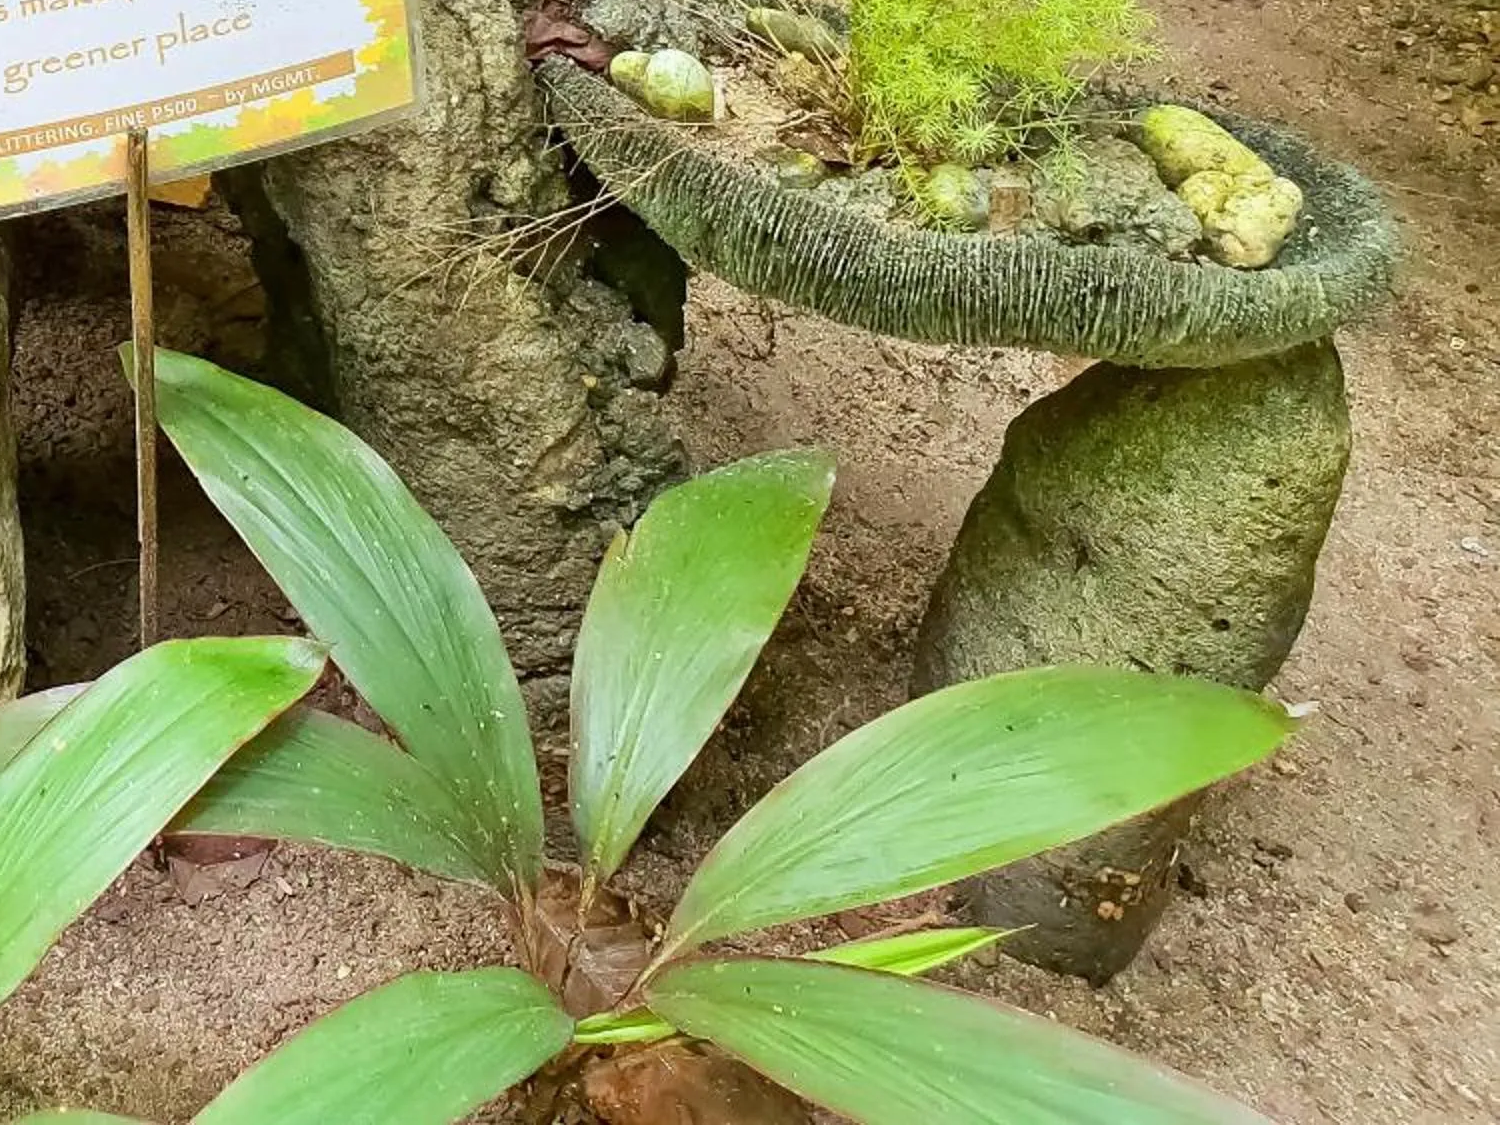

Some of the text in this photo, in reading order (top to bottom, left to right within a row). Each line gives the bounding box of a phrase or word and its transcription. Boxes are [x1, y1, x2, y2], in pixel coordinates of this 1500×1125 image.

[2, 10, 254, 95] greener place
[104, 109, 147, 132] FINE
[151, 97, 198, 121] P500
[224, 87, 249, 112] by
